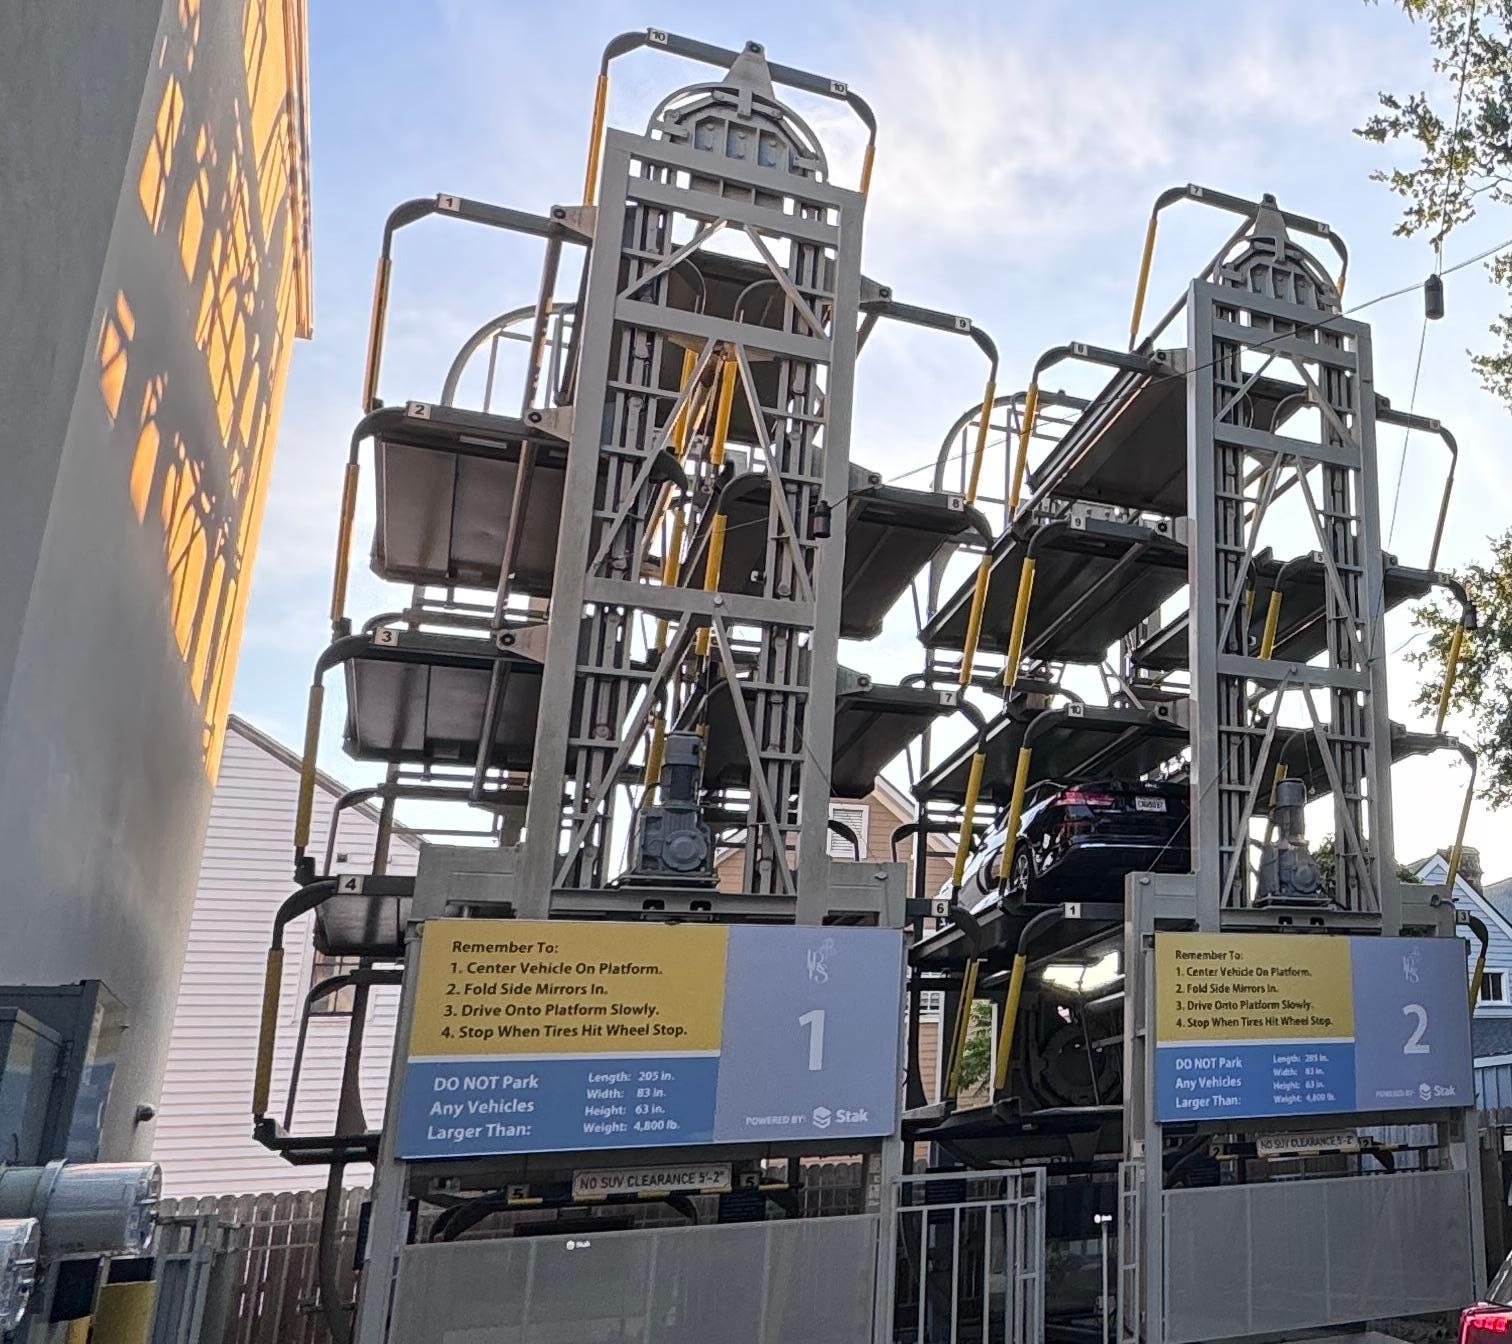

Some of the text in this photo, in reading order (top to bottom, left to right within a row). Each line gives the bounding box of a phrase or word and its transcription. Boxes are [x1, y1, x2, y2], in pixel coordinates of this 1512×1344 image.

[652, 31, 666, 42] 10
[833, 82, 845, 93] 10
[415, 405, 425, 416] 2
[952, 499, 960, 509] 8
[382, 631, 392, 643] 3
[945, 693, 953, 703] 7
[1071, 705, 1082, 715] 10
[345, 878, 357, 891] 4
[936, 902, 944, 914] 6
[452, 941, 559, 953] Remember To:
[1175, 950, 1243, 960] Remember To:
[451, 961, 663, 974] 1. Center Vehicle On Platform.
[1176, 966, 1312, 976] 1. Center Vehicle On Platform.
[446, 982, 608, 995] 2. Fold Side Mirrors In.
[1176, 983, 1279, 993] 2. Fold Side Mirrors In.
[443, 1002, 659, 1018] 3. Drive Onto Platform Slowly.
[1176, 999, 1314, 1011] 3. Drive Onto Platform Slowly.
[1176, 1016, 1334, 1029] 4. Stop When Tires Hit Wheel Stop.
[1403, 1004, 1430, 1054] 2
[441, 1023, 687, 1040] 4. Stop When Tires Hit Wheel Stop.
[799, 1009, 825, 1071] 1
[1176, 1056, 1242, 1070] DO NOT Park
[433, 1074, 539, 1091] DO NOT Park
[588, 1071, 675, 1084] Length: 205 in.
[1175, 1075, 1241, 1091] Any Vehicles
[586, 1087, 666, 1099] Width: 83 in.
[1434, 1084, 1455, 1096] Stak
[430, 1098, 534, 1118] Any Vehicles
[1176, 1095, 1241, 1110] Larger Than:
[585, 1103, 665, 1118] Height: 63 in.
[745, 1116, 790, 1125] POWERED
[835, 1109, 868, 1123] Stak
[428, 1122, 533, 1142] Larger Than:
[583, 1119, 680, 1134] Weight: 4,800 lb.
[580, 1177, 597, 1189] NO
[601, 1175, 624, 1189] SUV
[627, 1172, 695, 1187] CLEARANCE
[746, 1176, 756, 1187] 5
